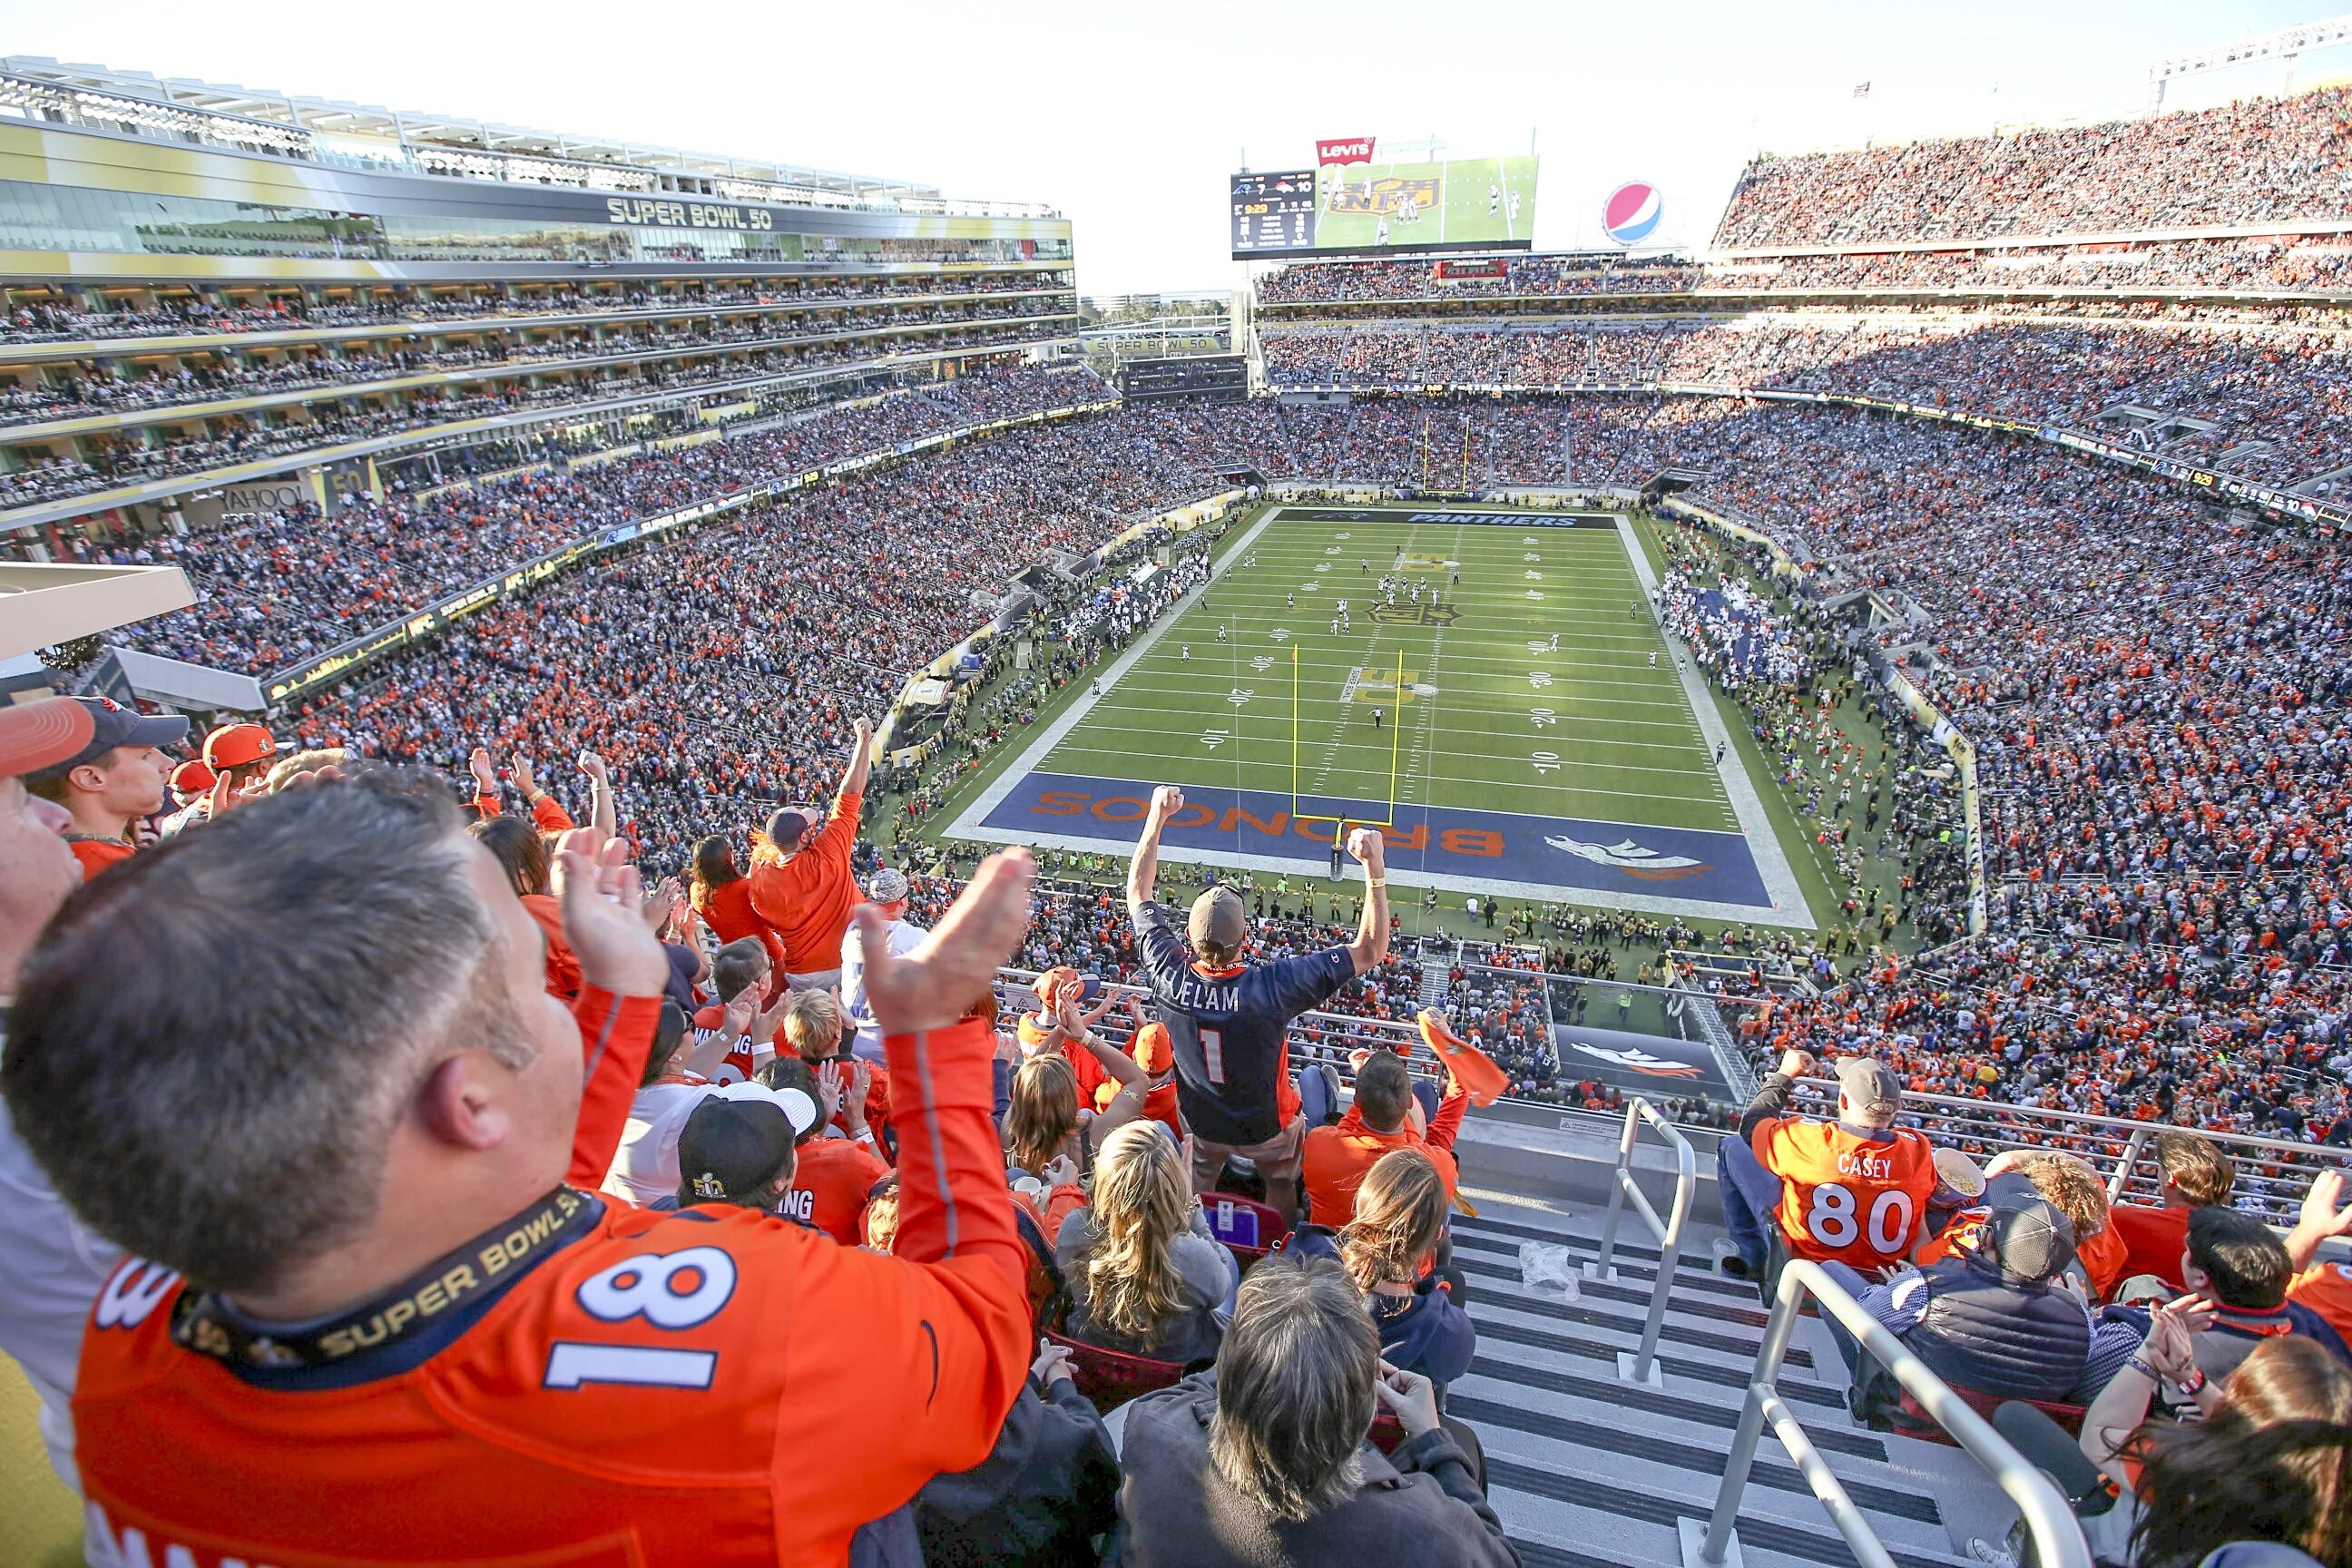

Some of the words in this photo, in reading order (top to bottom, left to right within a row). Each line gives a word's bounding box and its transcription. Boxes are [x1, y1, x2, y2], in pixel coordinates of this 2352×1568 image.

[1257, 183, 1266, 195] 7
[1297, 181, 1312, 192] 10
[607, 198, 687, 226] SUPER
[690, 204, 747, 229] BOWL
[749, 208, 772, 230] 50
[1244, 203, 1269, 215] 9:29
[1097, 340, 1142, 352] SUPER
[1148, 339, 1186, 350] BOWL
[1191, 339, 1207, 348] 50
[331, 470, 363, 493] 50
[220, 485, 303, 512] YAHOO!
[2287, 499, 2300, 513] 10
[1407, 514, 1577, 526] PANTHERS
[1250, 655, 1275, 669] 30
[1353, 668, 1420, 705] 50
[1529, 671, 1553, 689] 30
[1227, 688, 1255, 703] 20
[1530, 708, 1556, 725] 20
[1200, 729, 1230, 744] 10
[1532, 751, 1561, 770] 10
[1030, 790, 1506, 858] BRONCOS
[1180, 981, 1240, 1013] ELAM
[1199, 1027, 1225, 1084] 1
[1837, 1152, 1891, 1180] CASEY
[692, 1177, 726, 1195] 50
[1808, 1182, 1914, 1255] 80
[319, 1263, 478, 1358] SUPER
[478, 1210, 564, 1276] BOWL
[543, 1246, 737, 1391] 18
